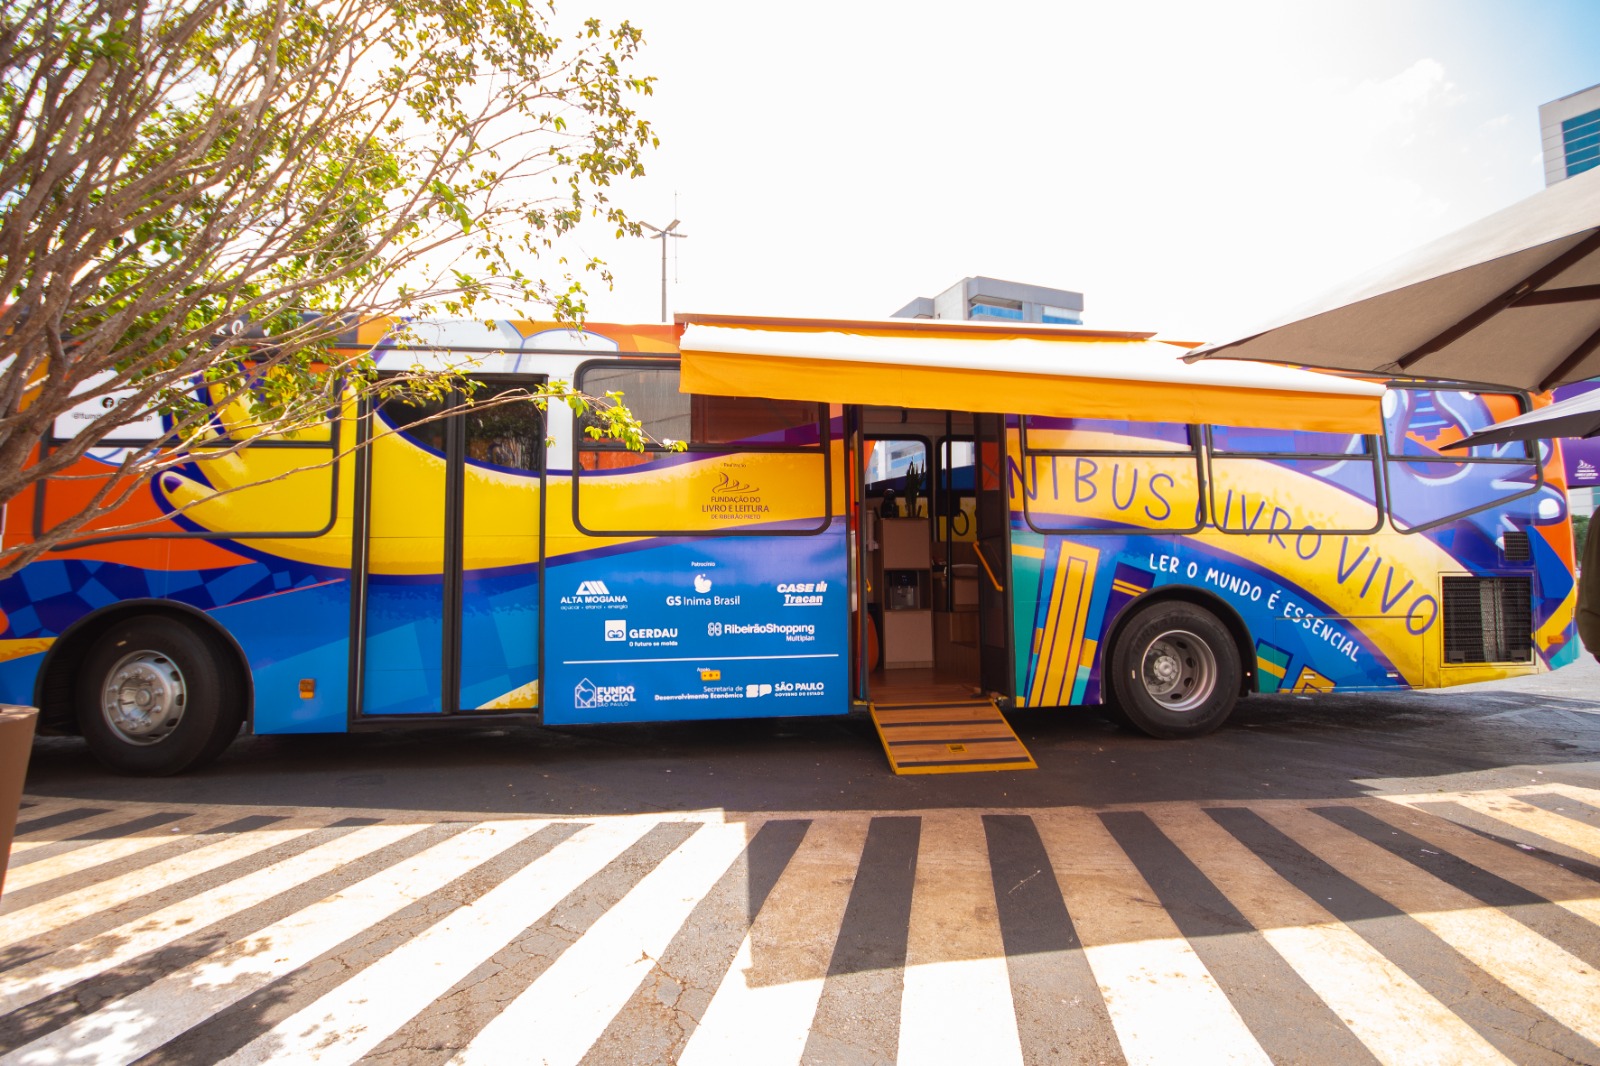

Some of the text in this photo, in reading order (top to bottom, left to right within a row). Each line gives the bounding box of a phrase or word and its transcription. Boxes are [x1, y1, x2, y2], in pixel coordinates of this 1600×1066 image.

[710, 495, 749, 503] FUNDAÇÃO
[701, 504, 770, 513] LIVRO E LEITURA
[1007, 455, 1439, 636] NIBUS LIVRO VIVO
[776, 583, 815, 593] CASE
[560, 595, 628, 604] ALTA MOGIANA
[665, 595, 741, 606] GS Inima Brasil
[784, 594, 824, 604] Tracan
[1149, 553, 1360, 662] LER O MUNDO É ESSENCIAL
[628, 628, 678, 639] GERDAU
[724, 623, 815, 635] RibeirãoShopping
[597, 685, 635, 695] FUNDO
[703, 685, 733, 693] Secretaria
[774, 681, 824, 692] SÃO PAULO
[597, 693, 637, 703] SOCIAL
[654, 691, 744, 701] Desenvolvimento Econômico
